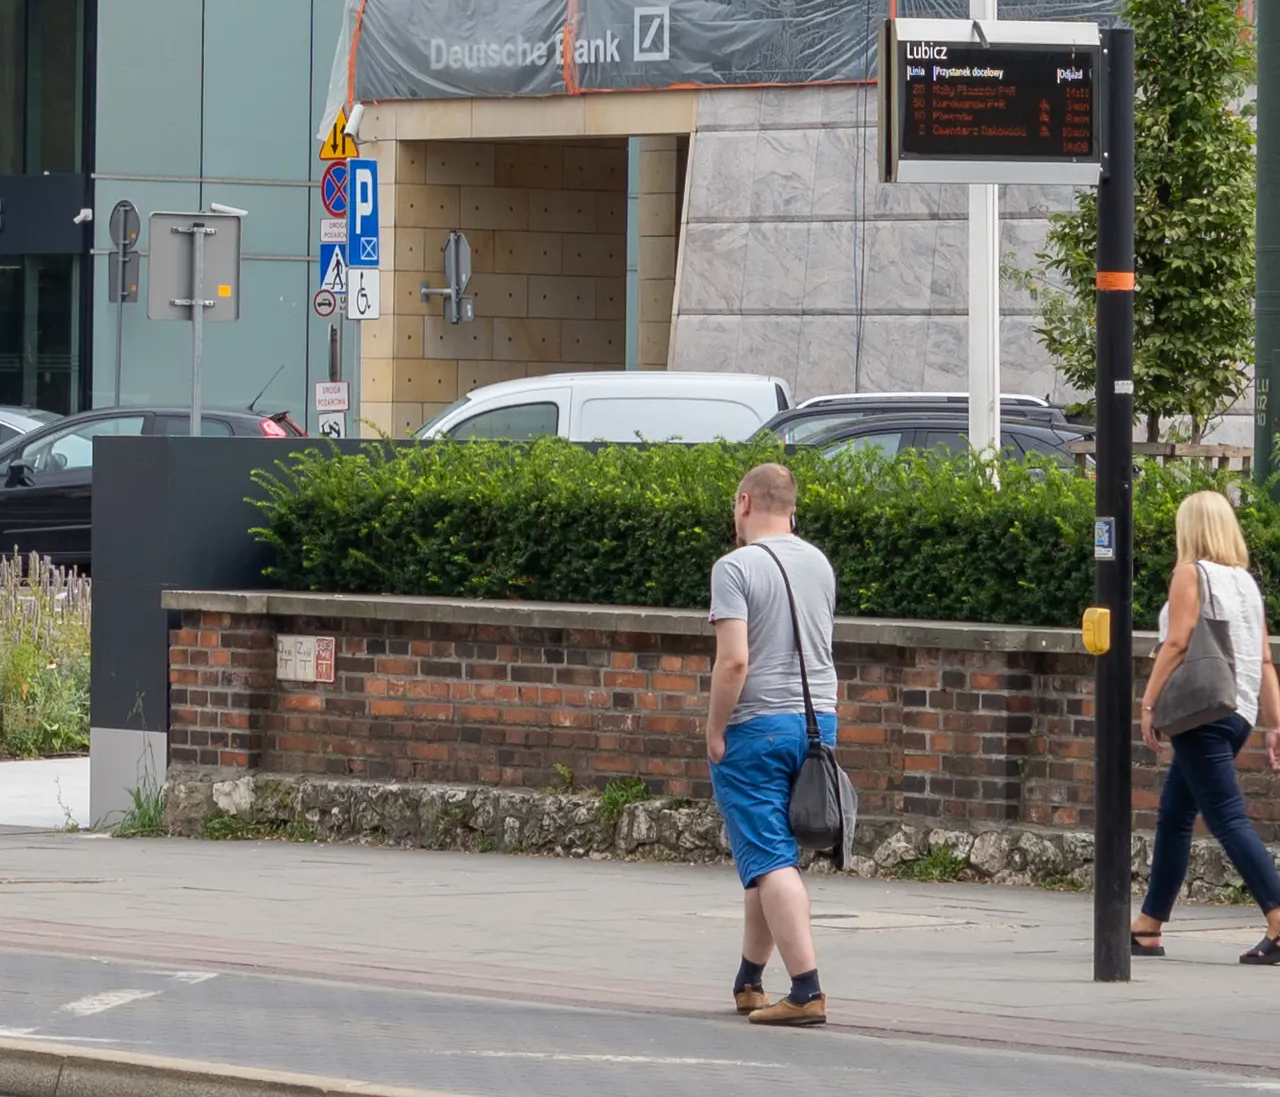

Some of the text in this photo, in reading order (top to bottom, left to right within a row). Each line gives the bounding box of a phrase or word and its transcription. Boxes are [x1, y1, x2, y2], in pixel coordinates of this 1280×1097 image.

[430, 36, 548, 70] Deutsche
[906, 42, 948, 60] Lubicz
[908, 66, 925, 77] Linia
[935, 66, 971, 79] Przystanek
[972, 67, 1004, 79] docelowy
[355, 168, 373, 235] P
